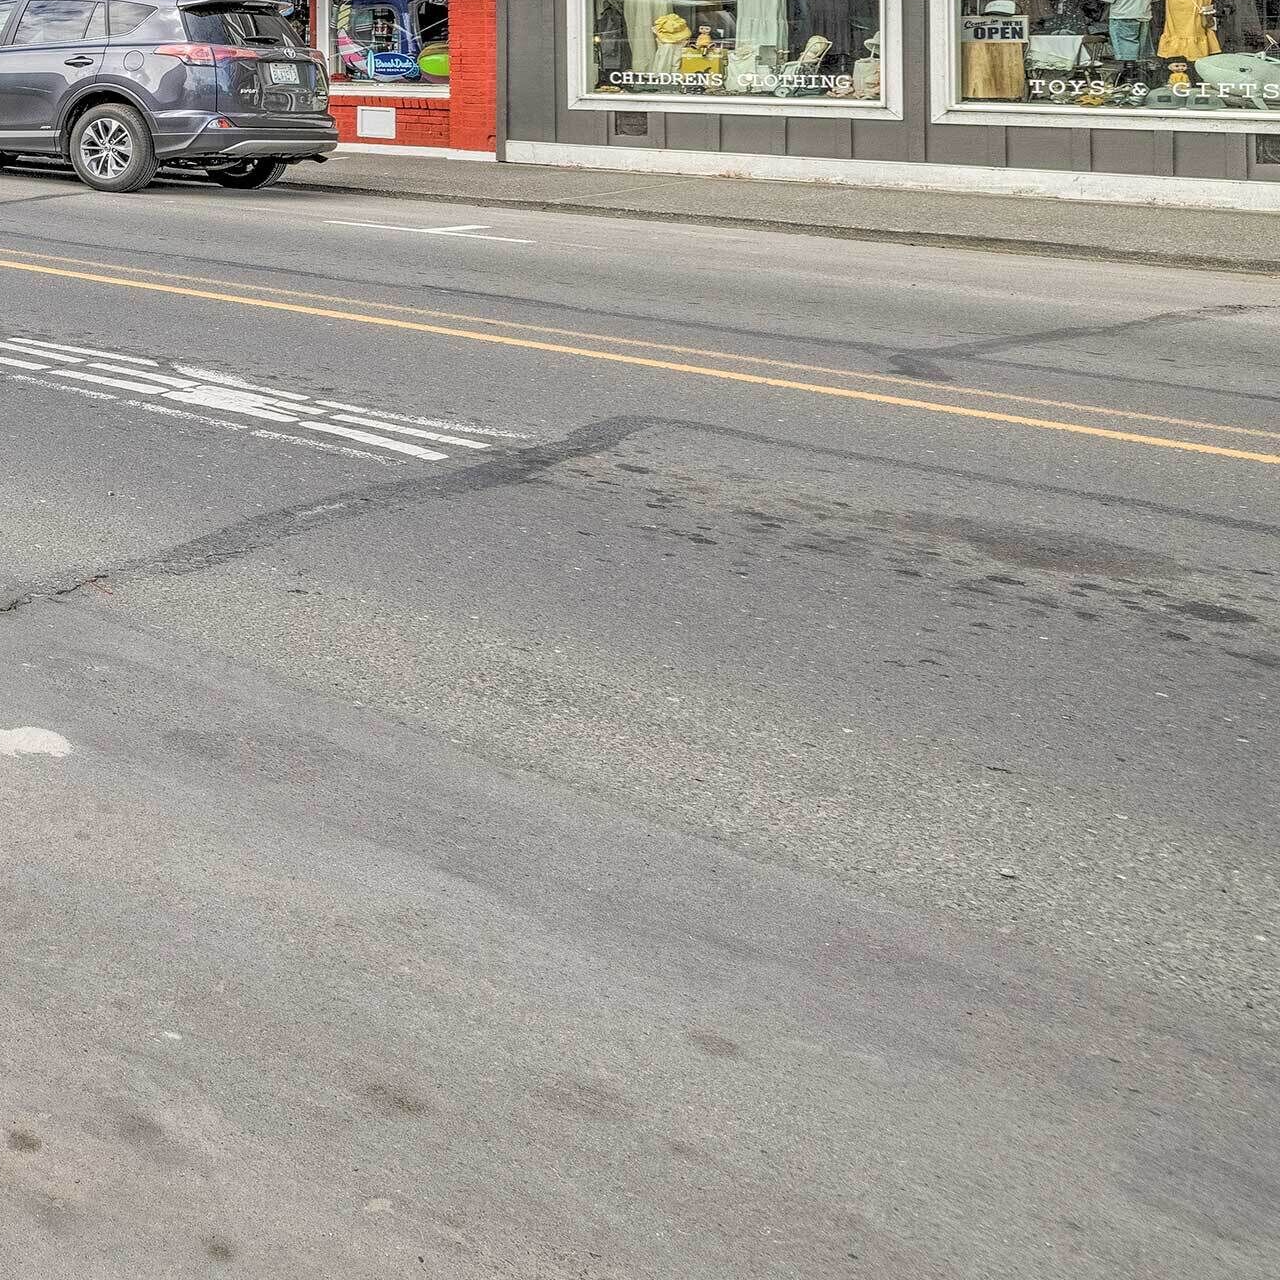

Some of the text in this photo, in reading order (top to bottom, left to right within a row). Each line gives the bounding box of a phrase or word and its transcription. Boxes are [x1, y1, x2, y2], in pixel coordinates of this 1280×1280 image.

[973, 27, 1024, 40] OPEN
[609, 71, 851, 89] CHILDRENS CLOTHING
[1029, 79, 1280, 100] TOYS & GIFTS
